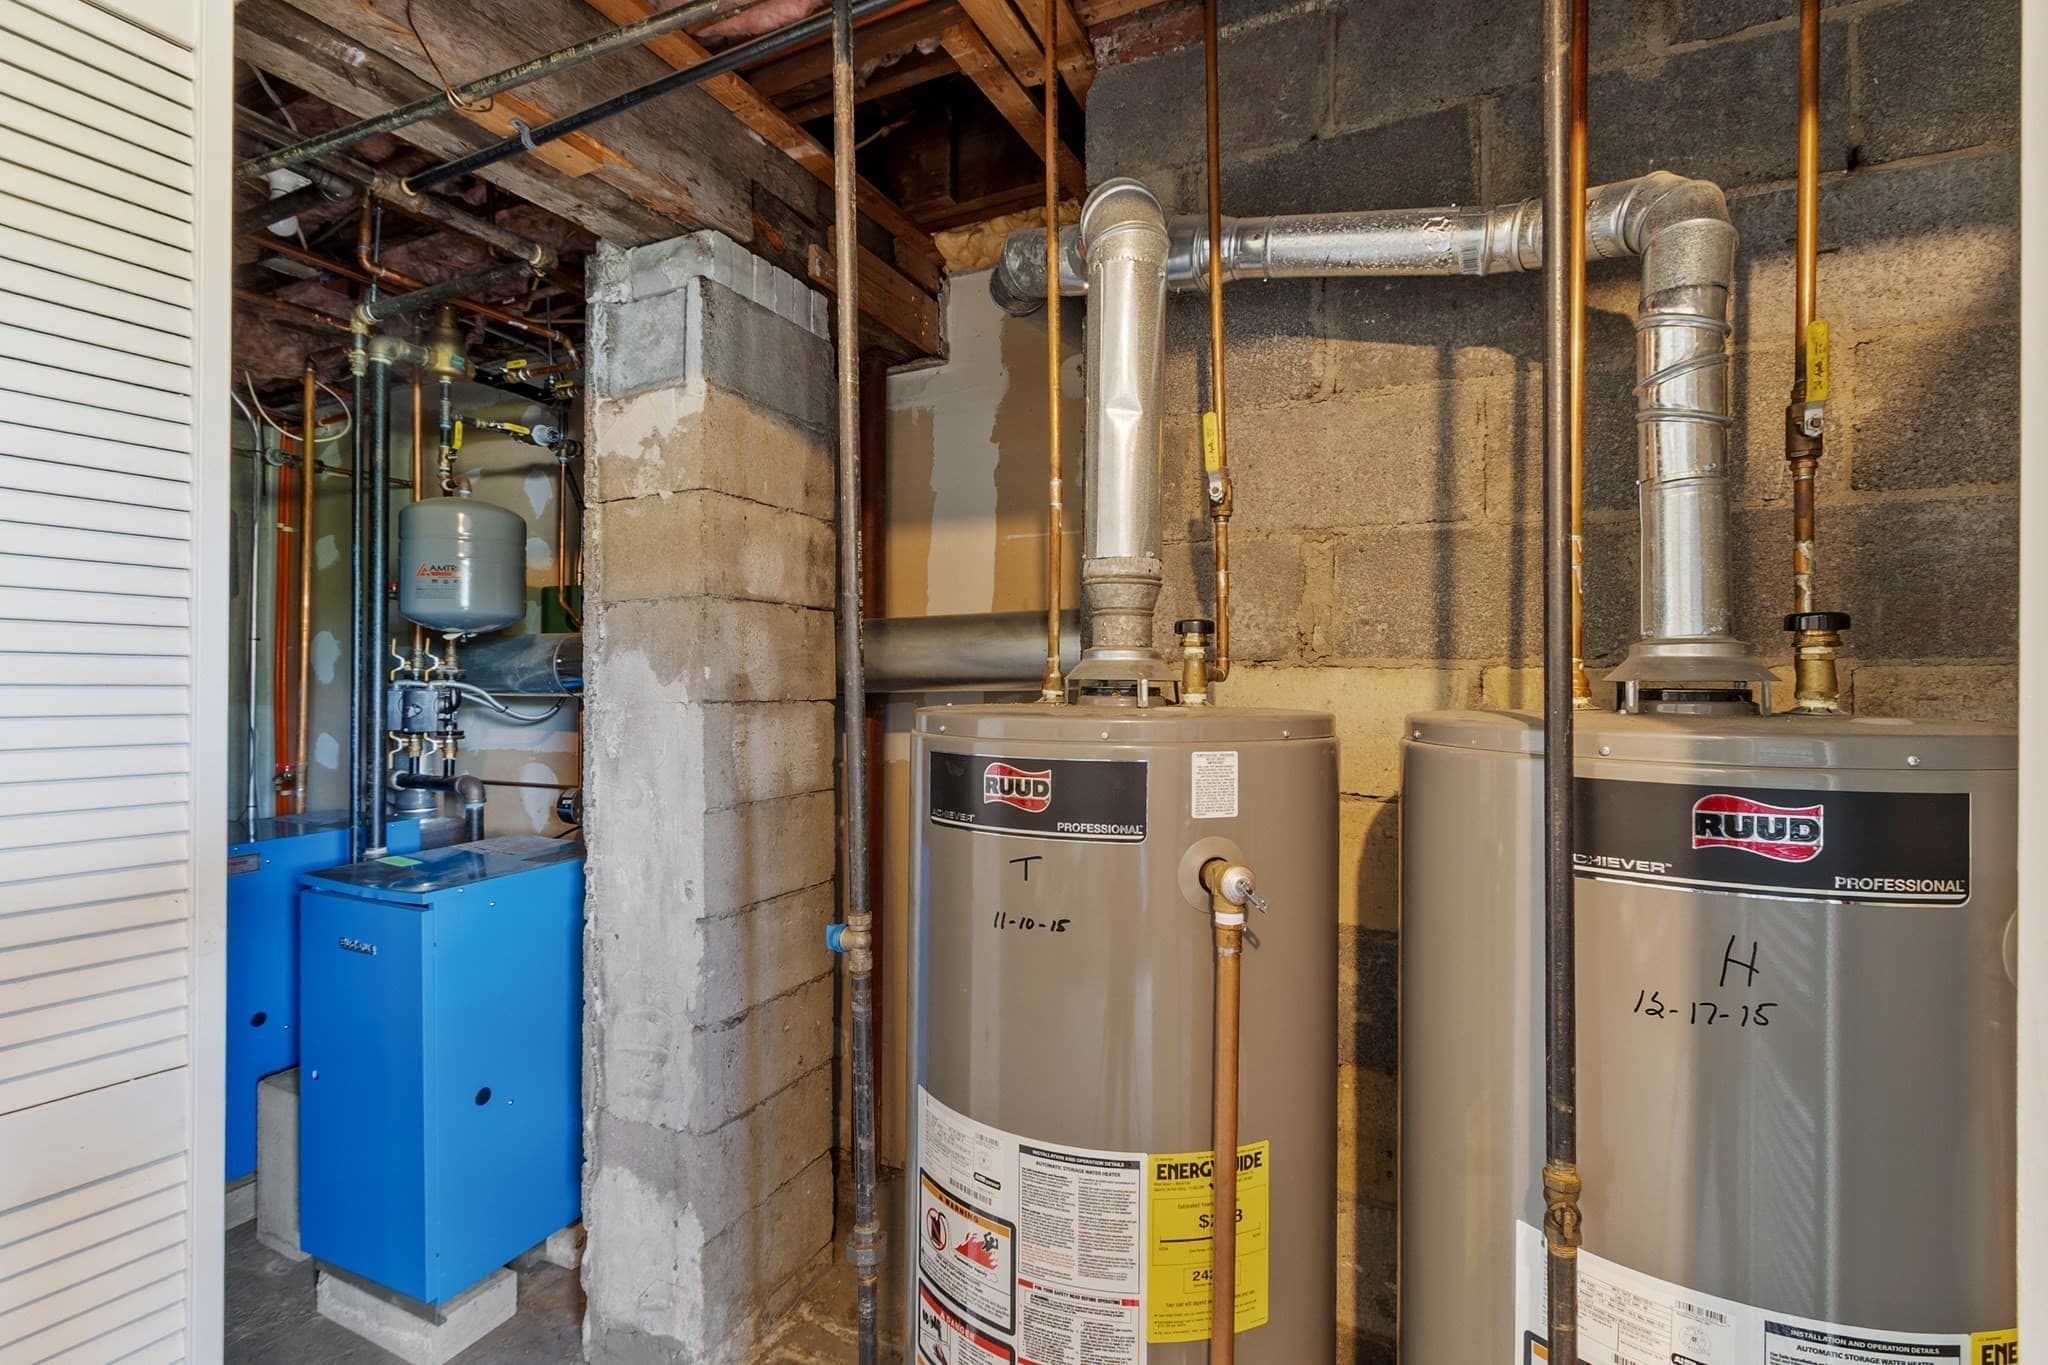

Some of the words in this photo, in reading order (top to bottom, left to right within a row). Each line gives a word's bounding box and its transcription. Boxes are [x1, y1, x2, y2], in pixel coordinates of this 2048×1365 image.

[984, 776, 1050, 798] RUUD
[1057, 822, 1144, 835] PROFESSIONAL
[1695, 812, 1821, 842] RUUD
[1009, 856, 1042, 881] T
[1573, 853, 1666, 874] CHIEVER
[1834, 876, 1965, 892] PROFESSIONAL
[993, 911, 1071, 932] 11-10-15
[1719, 934, 1760, 987] H
[1062, 1165, 1085, 1175] STORAGE
[945, 1313, 975, 1342] DANGER
[1790, 1328, 1847, 1346] INSTALLATION
[1848, 1340, 1866, 1349] AND
[1867, 1342, 1909, 1353] OPERATION
[1911, 1347, 1940, 1355] DETAILS
[1796, 1344, 1842, 1360] AUTOMATIC
[1844, 1353, 1880, 1364] STORAGE
